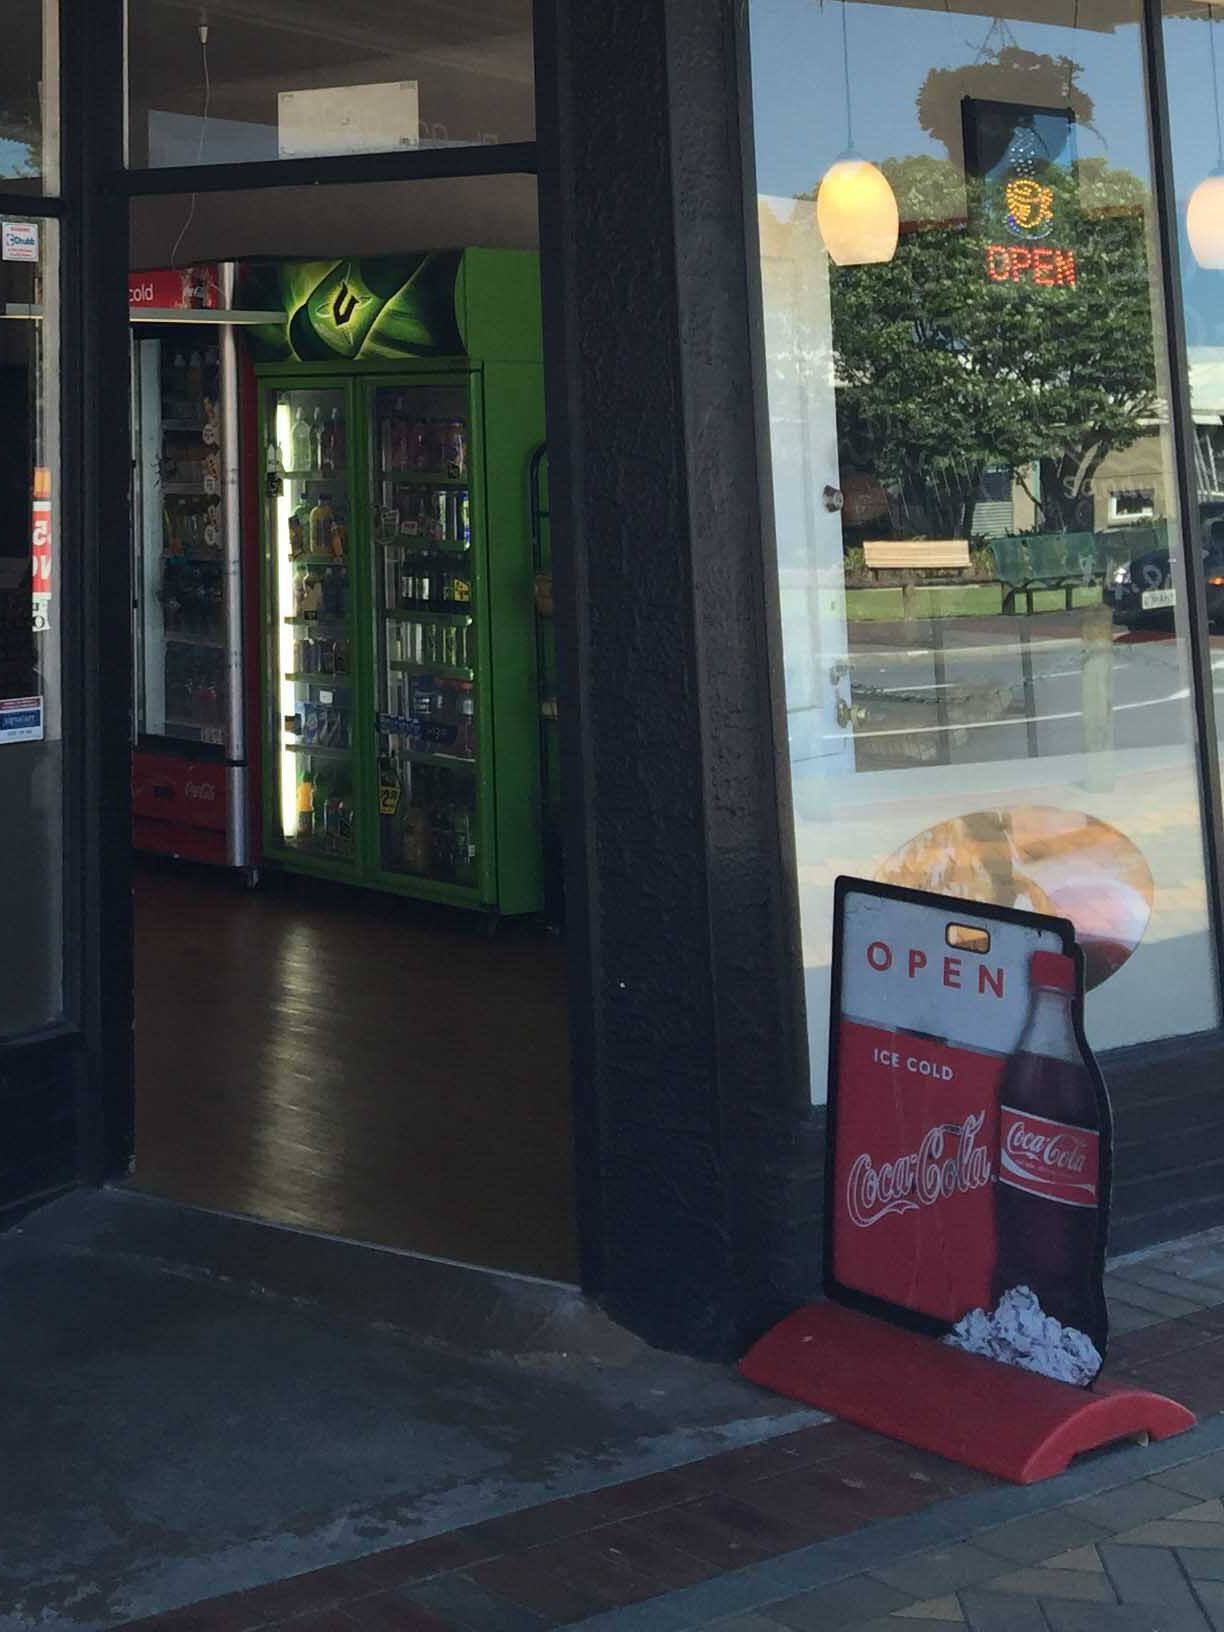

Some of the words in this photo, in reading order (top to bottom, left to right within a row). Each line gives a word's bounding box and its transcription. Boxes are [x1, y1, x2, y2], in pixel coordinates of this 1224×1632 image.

[986, 244, 1076, 286] OPEN
[866, 940, 1004, 999] OPEN
[874, 1047, 901, 1068] ICE
[907, 1059, 954, 1081] COLD
[847, 1110, 993, 1228] Coca-Cola
